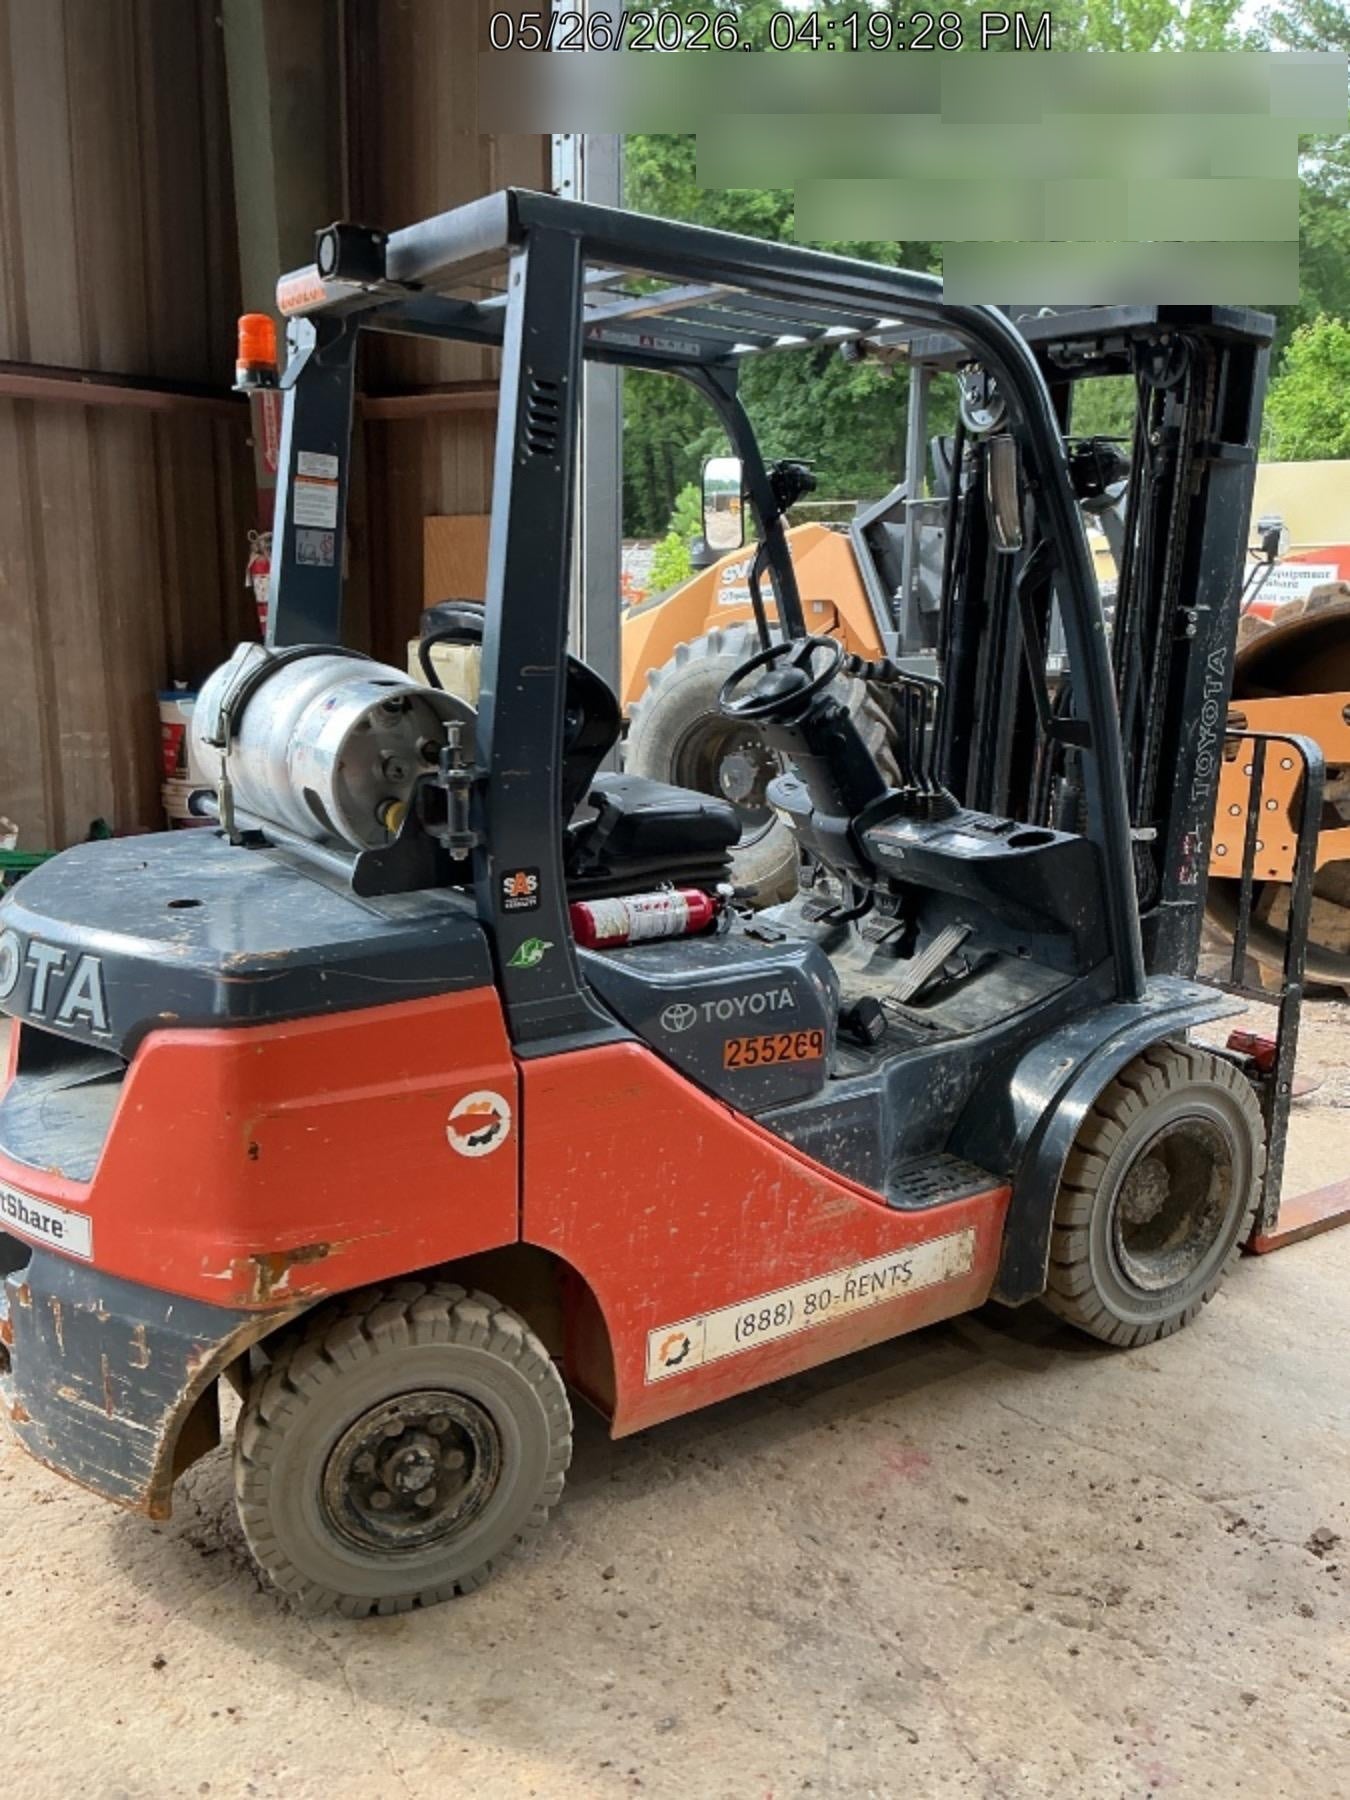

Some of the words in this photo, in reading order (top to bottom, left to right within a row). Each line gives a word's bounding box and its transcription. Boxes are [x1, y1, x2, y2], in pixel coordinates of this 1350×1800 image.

[1191, 648, 1227, 798] TOYOTA
[503, 871, 538, 897] SAS
[702, 987, 795, 1023] TOYOTA
[727, 1031, 823, 1067] 255269
[734, 1300, 794, 1343] (888)
[803, 1260, 913, 1316] 80-RENTS
